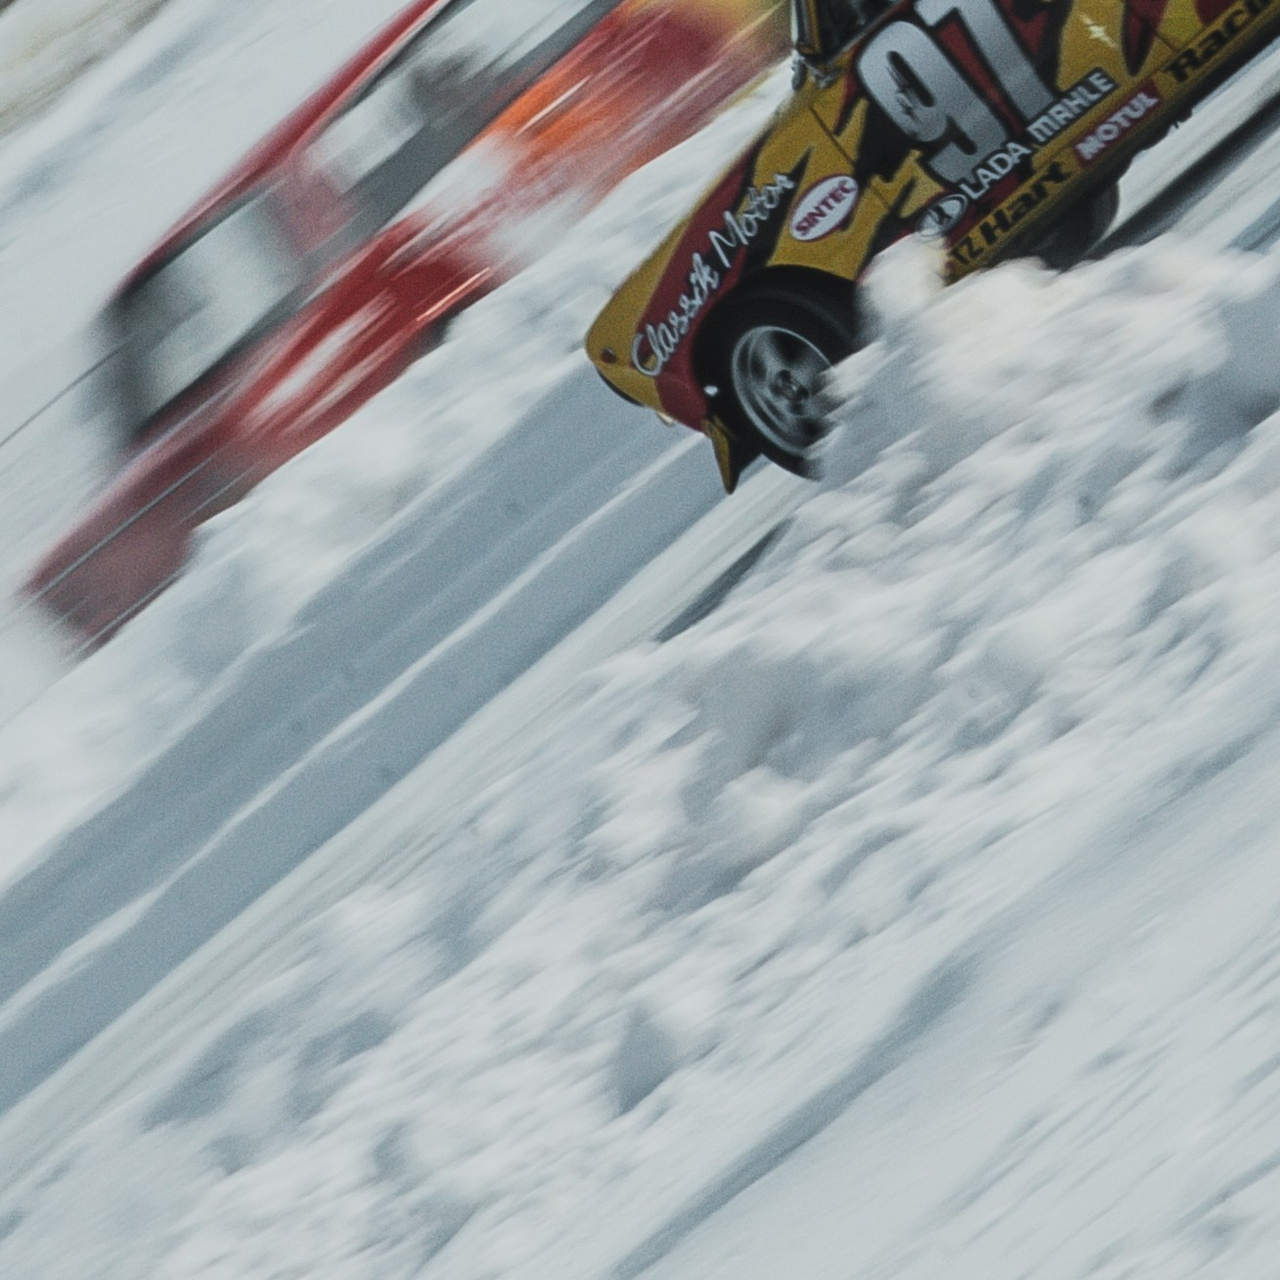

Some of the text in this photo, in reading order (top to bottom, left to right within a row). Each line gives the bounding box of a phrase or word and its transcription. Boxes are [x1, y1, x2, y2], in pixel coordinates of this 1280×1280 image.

[1027, 72, 1116, 143] MAHLE
[1074, 91, 1159, 161] MOTUL
[960, 141, 1033, 200] LADA
[979, 161, 1073, 246] Hart
[794, 178, 856, 237] SINTEC
[631, 251, 720, 378] Classik
